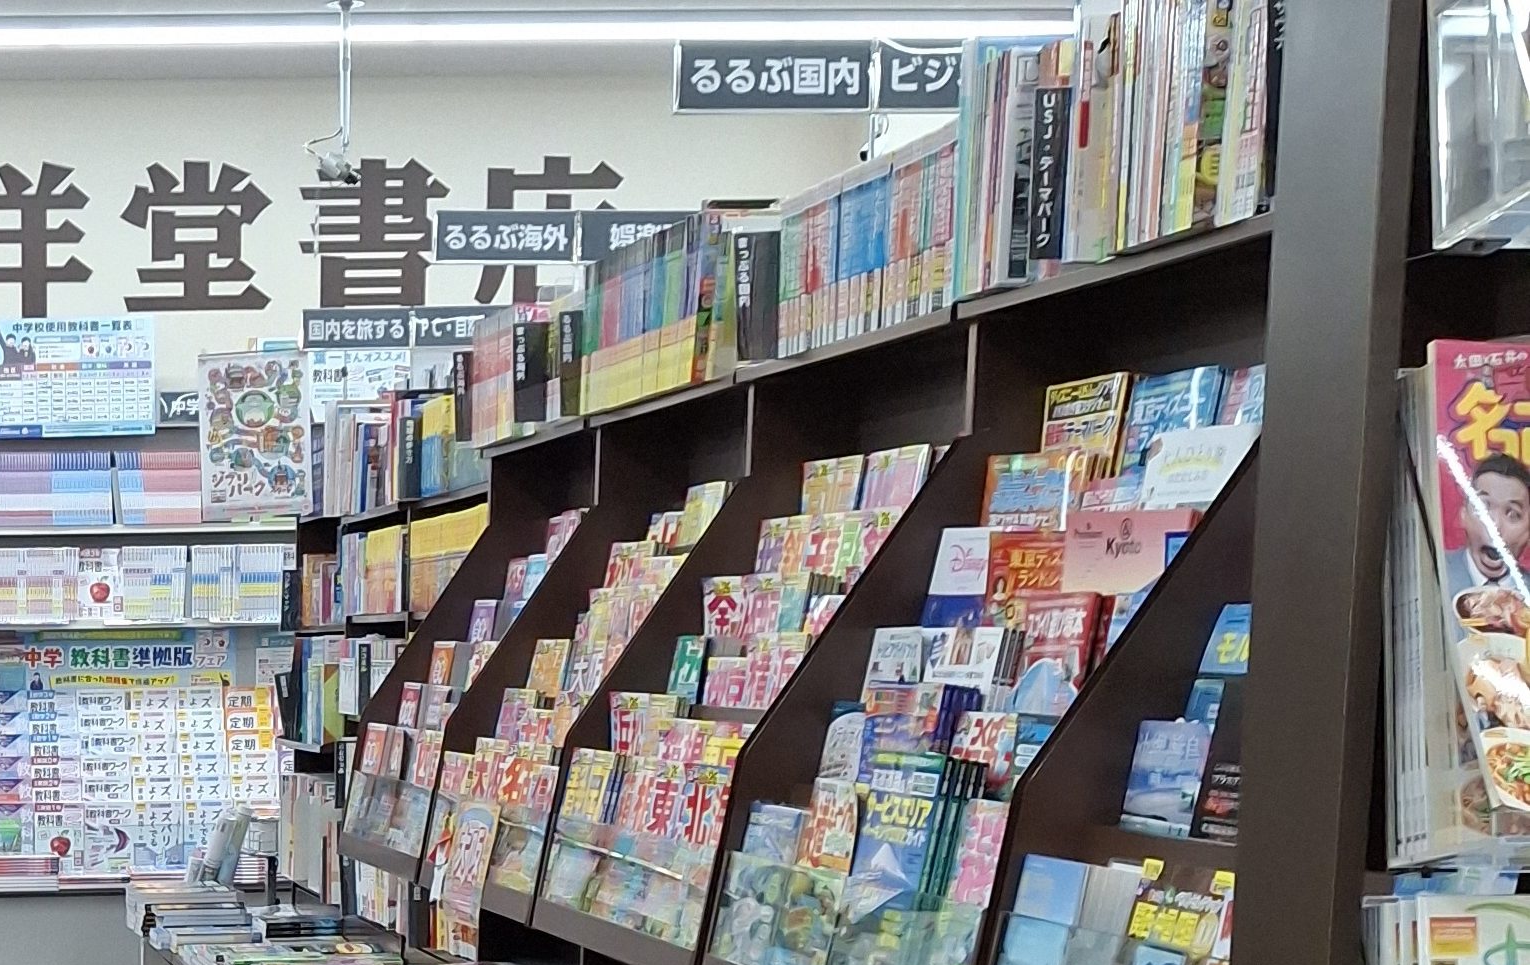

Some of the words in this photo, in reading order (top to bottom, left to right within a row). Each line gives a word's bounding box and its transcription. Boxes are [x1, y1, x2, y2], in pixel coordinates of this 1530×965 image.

[689, 56, 860, 96] るるぶ国内
[891, 57, 960, 93] ビジ
[1036, 91, 1057, 250] USJ・テーマパーク
[444, 223, 569, 251] るるぶ海外
[308, 318, 405, 342] 国内を旅する
[1105, 538, 1142, 560] Kyoto
[23, 646, 63, 669] 中学
[70, 645, 194, 668] 教科書準拠版
[196, 653, 227, 668] フェア
[227, 695, 252, 708] 定期
[229, 717, 254, 729] 定期
[232, 739, 256, 751] 定期
[35, 790, 60, 801] 教科書
[37, 814, 63, 826] 教科書
